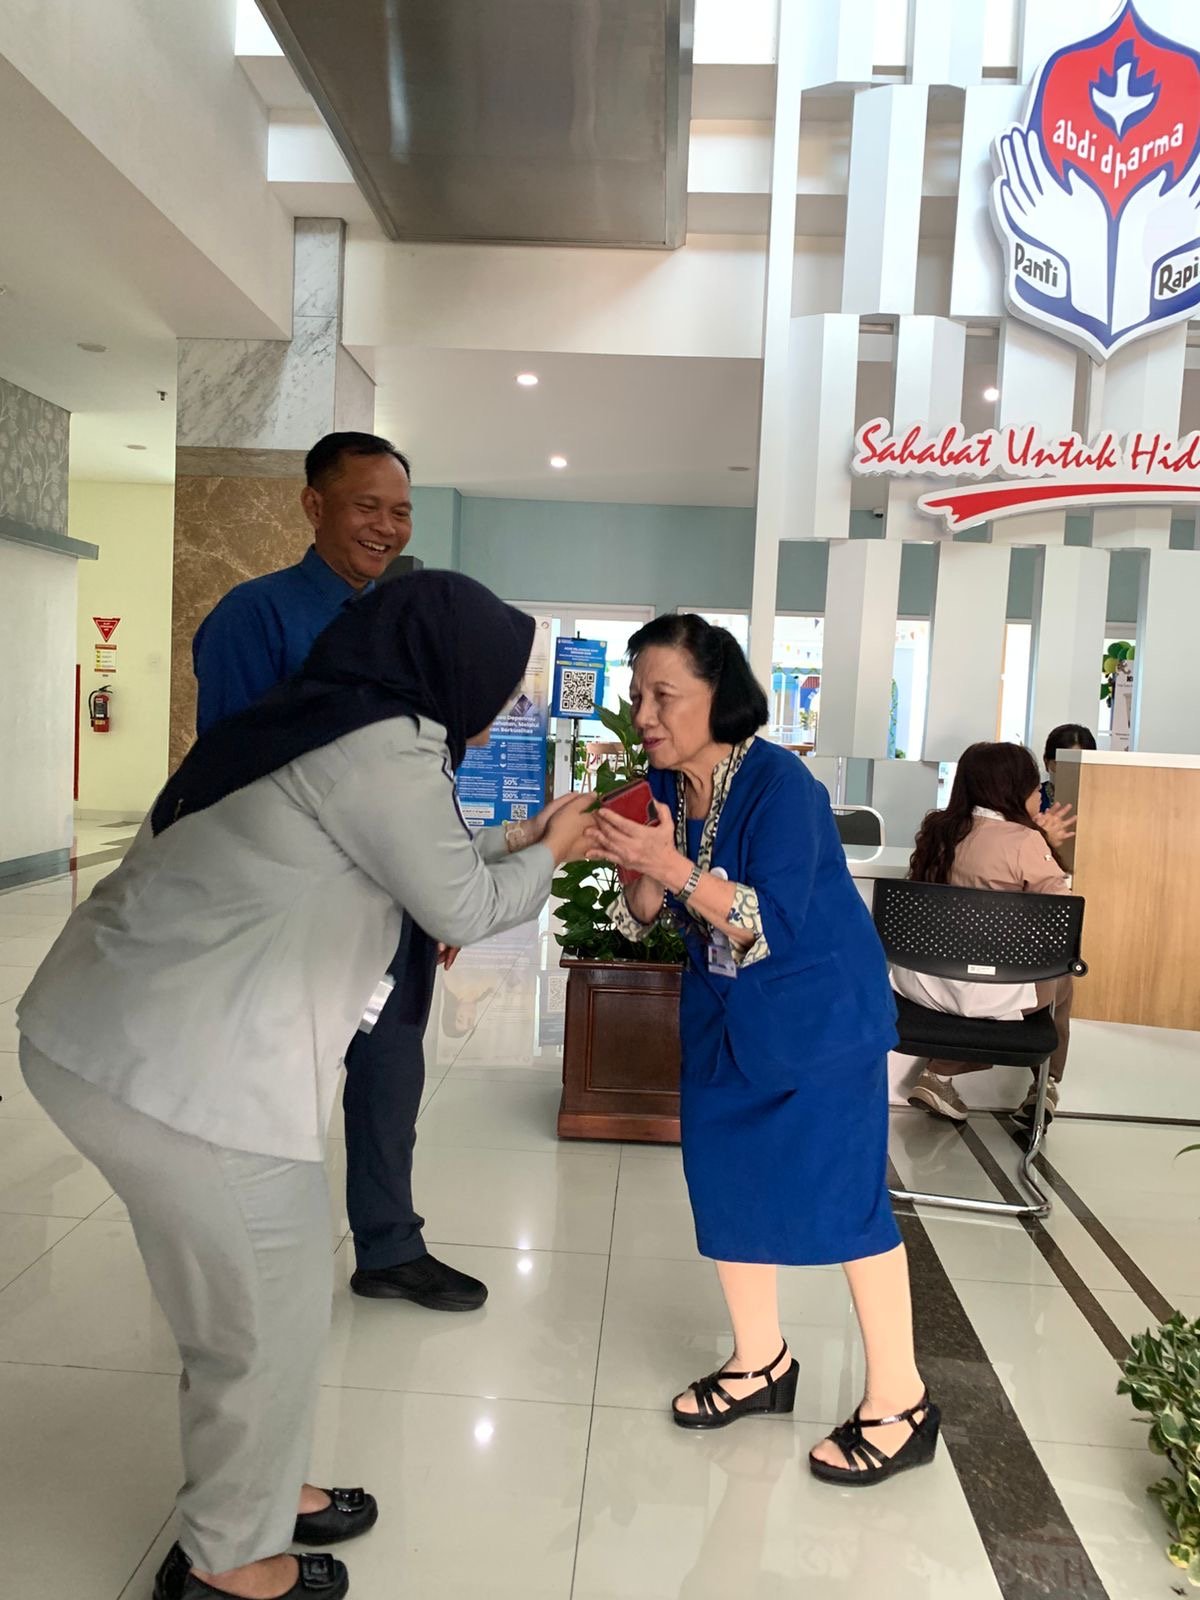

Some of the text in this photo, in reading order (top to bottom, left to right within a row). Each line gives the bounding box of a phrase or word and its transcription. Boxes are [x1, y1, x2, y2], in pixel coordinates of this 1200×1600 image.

[1053, 119, 1184, 189] abdi dharma
[1014, 242, 1059, 288] Panti
[1158, 256, 1200, 296] Rapi
[860, 423, 993, 467] Sahabat
[1007, 426, 1117, 471] Untuk
[503, 778, 518, 786] 50%
